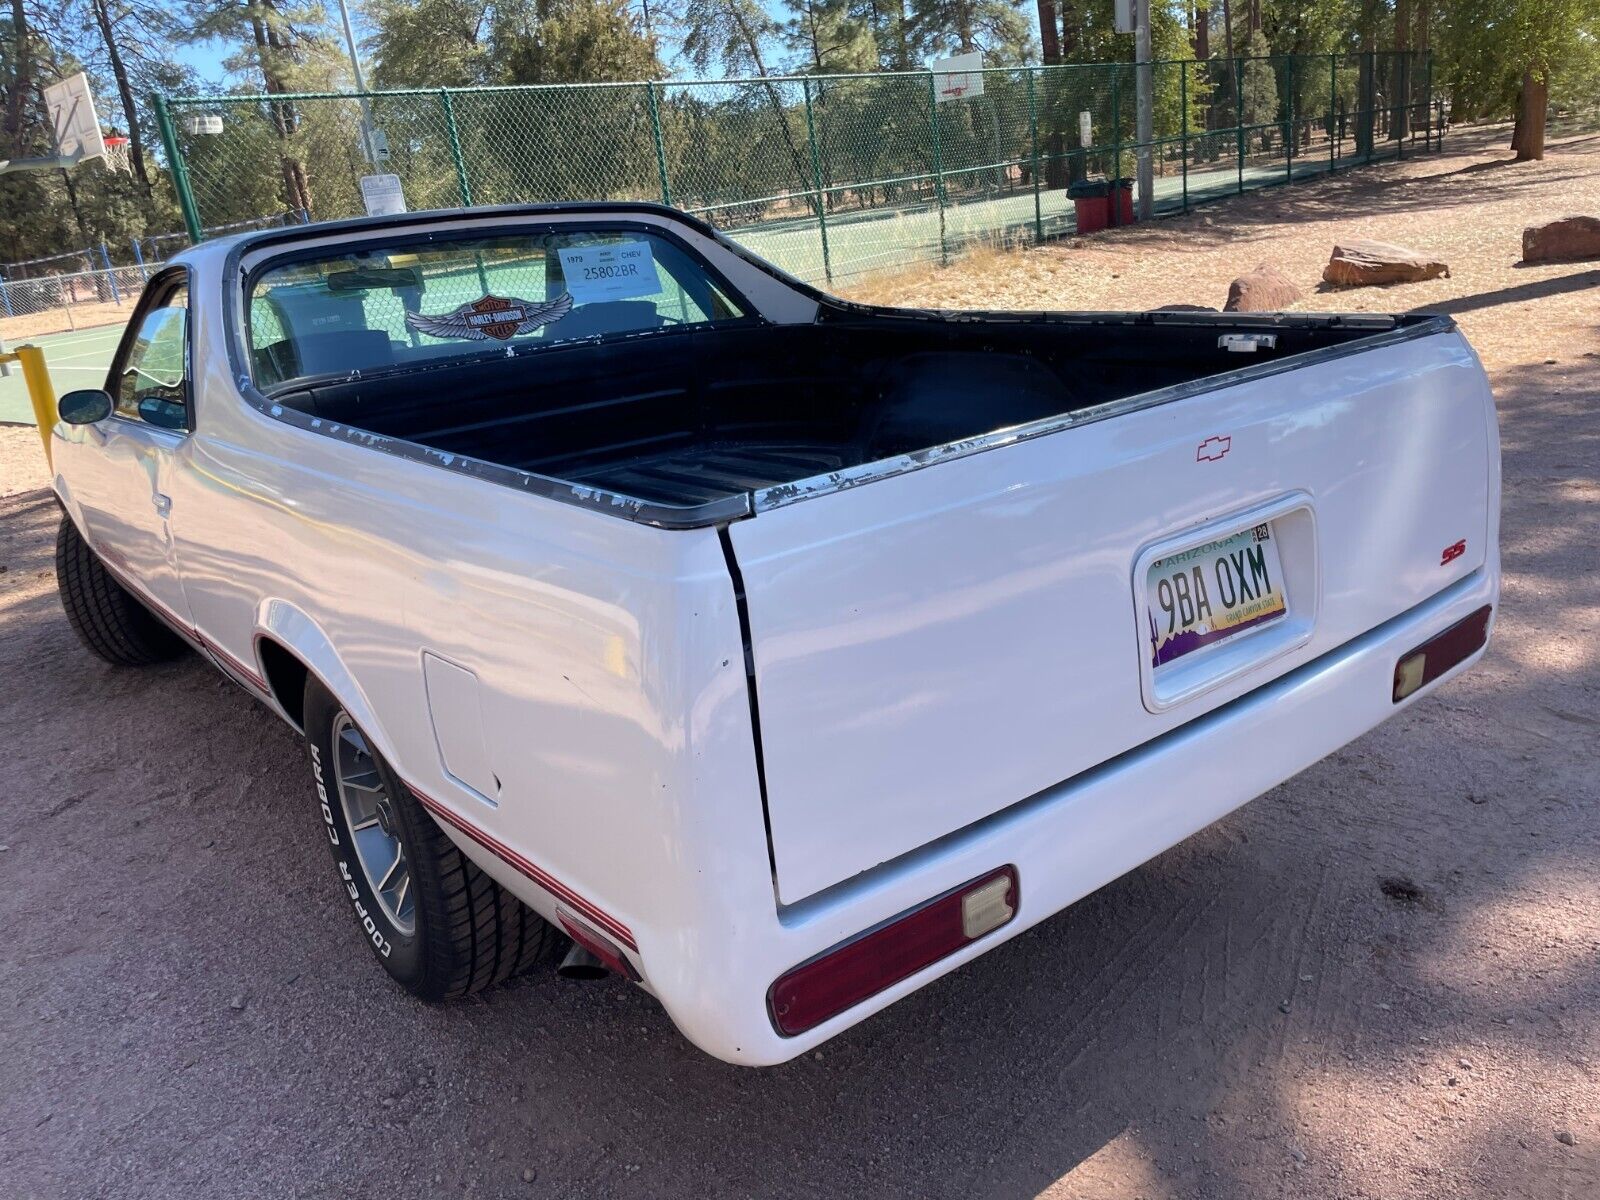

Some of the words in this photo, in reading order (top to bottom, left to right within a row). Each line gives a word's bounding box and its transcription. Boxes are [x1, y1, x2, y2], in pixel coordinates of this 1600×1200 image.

[621, 250, 641, 259] CHEV
[584, 263, 639, 280] 25802BR
[1166, 538, 1234, 568] ARIZONA
[1440, 538, 1467, 566] SS
[1157, 565, 1213, 634] 9BA
[1242, 602, 1262, 617] CANYON
[310, 743, 340, 846] COBRA
[338, 860, 392, 958] COOPER
